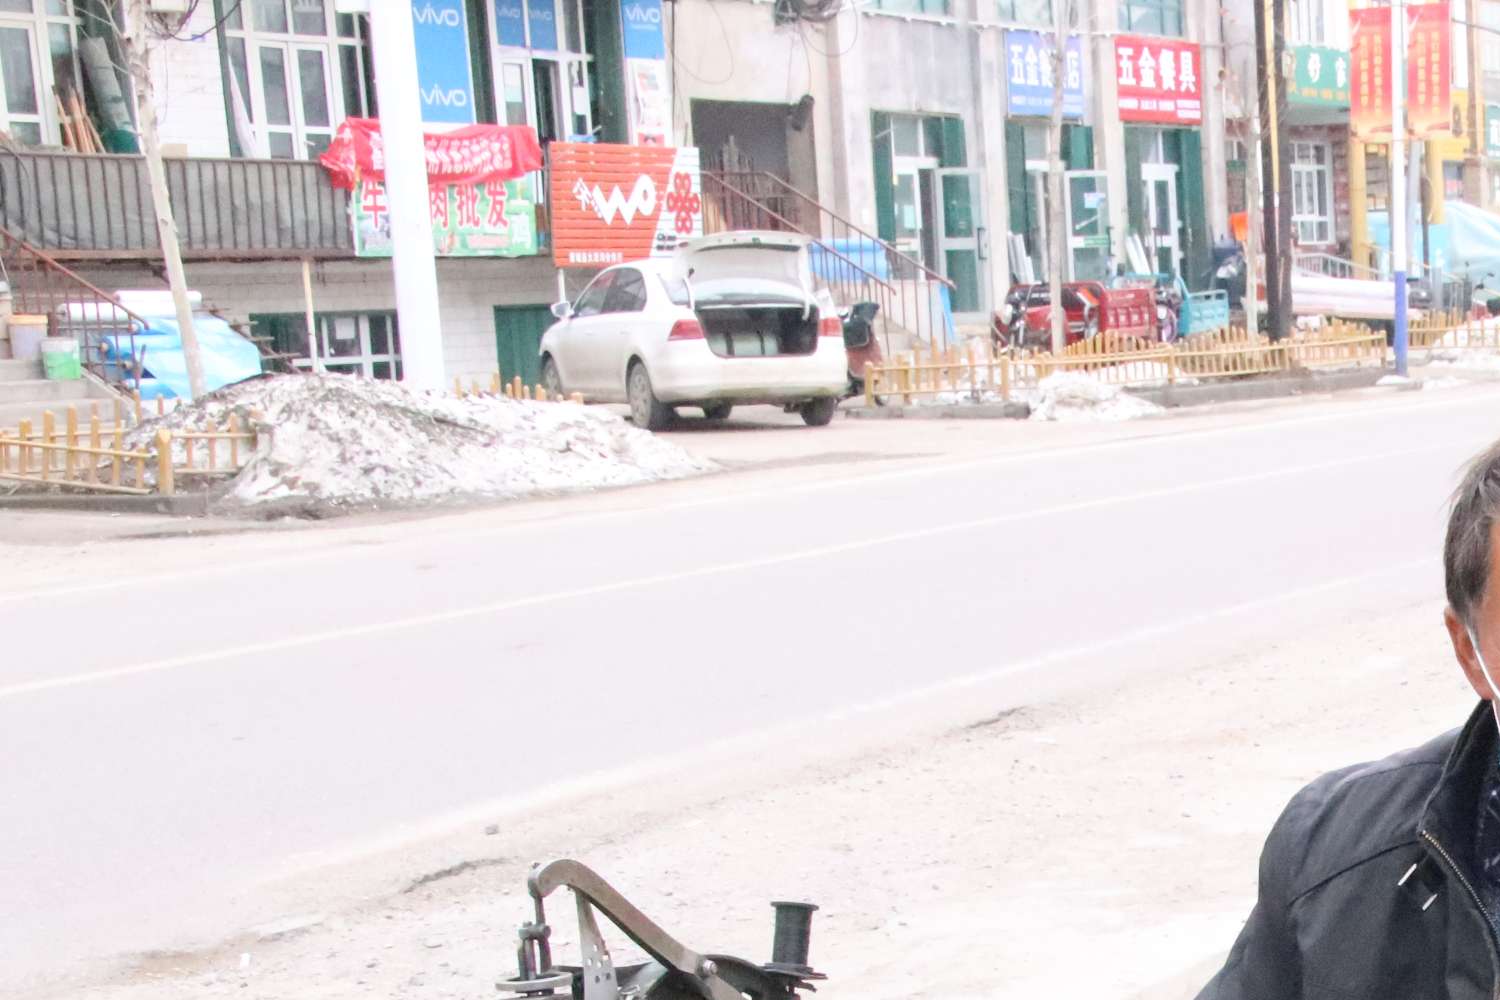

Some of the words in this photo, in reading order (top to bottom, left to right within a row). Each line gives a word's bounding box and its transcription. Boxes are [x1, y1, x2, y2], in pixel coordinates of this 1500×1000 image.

[412, 4, 459, 27] vivo
[625, 3, 661, 24] vivo
[1010, 44, 1079, 89] 五金餐店
[1117, 47, 1196, 93] 五金餐具
[420, 84, 467, 107] vivo
[361, 180, 509, 230] 牛肉批发
